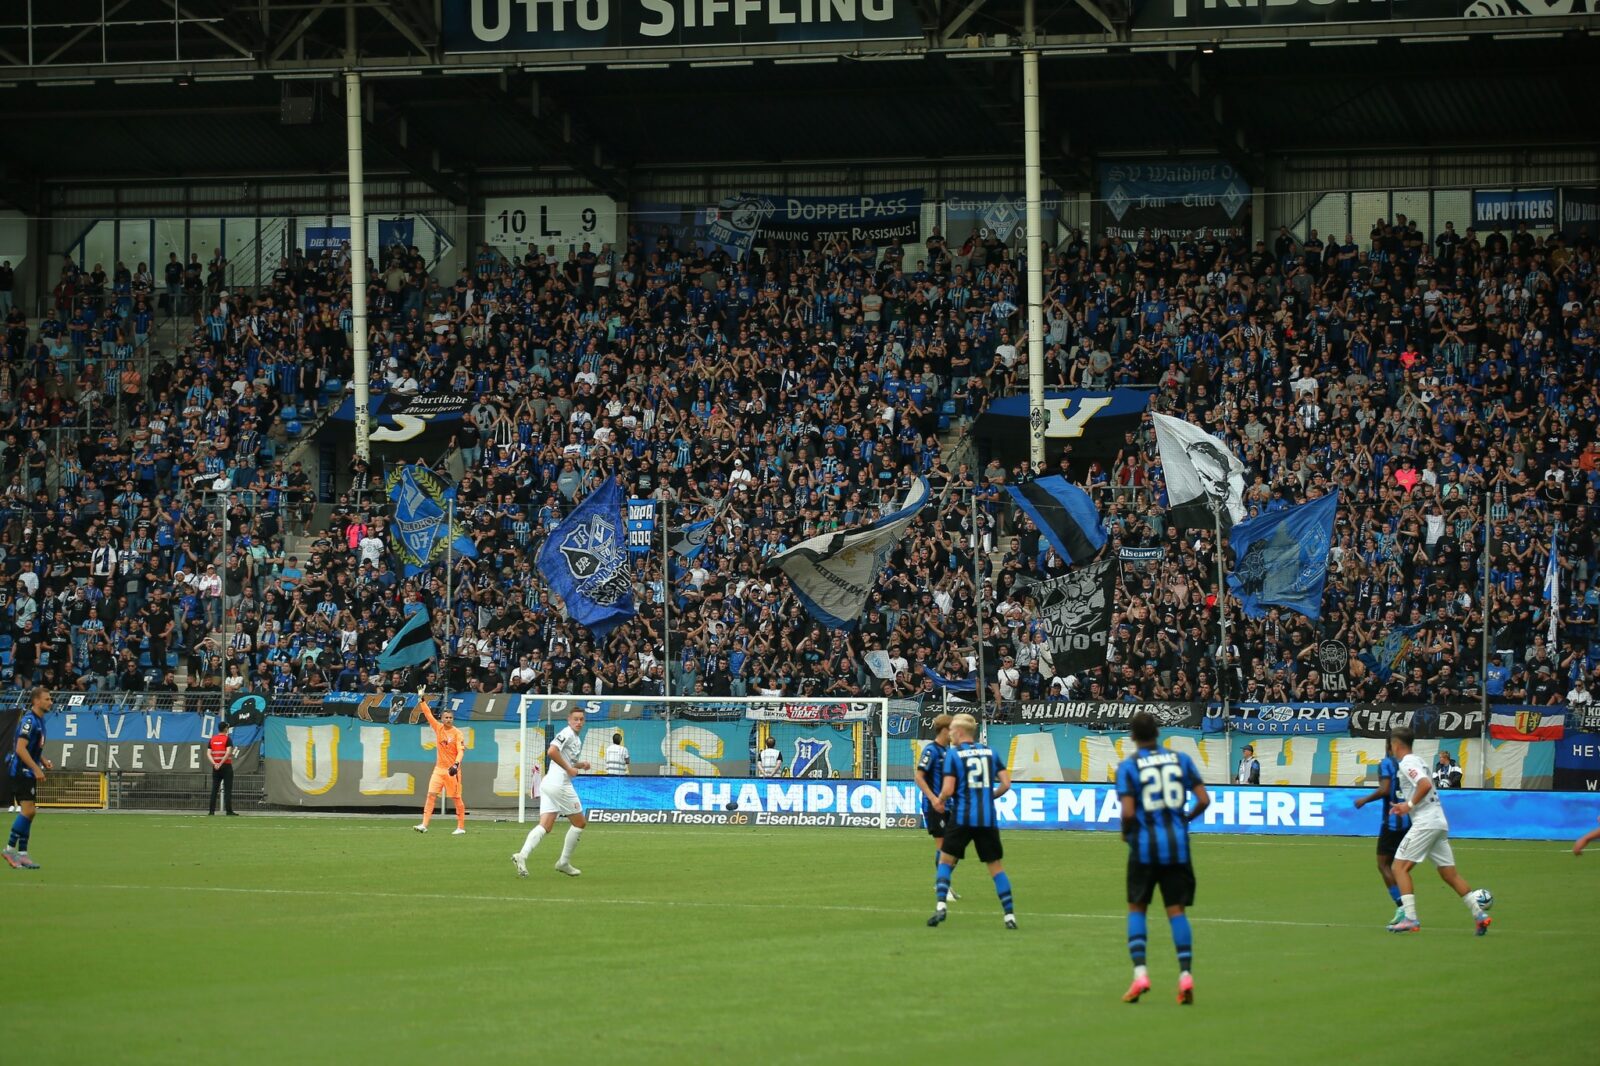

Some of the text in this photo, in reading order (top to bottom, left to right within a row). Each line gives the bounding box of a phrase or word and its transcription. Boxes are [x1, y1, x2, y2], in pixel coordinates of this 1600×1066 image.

[639, 0, 893, 37] SIFFLING
[787, 197, 907, 220] DOPPELPASS
[1477, 200, 1554, 221] KAPUTTICKS
[498, 205, 597, 236] 10 L 9
[756, 229, 809, 241] TIMMUNG
[852, 221, 917, 241] RASSISMUS!
[410, 394, 468, 406] Barrikade
[1229, 721, 1326, 731] MMORTALE
[912, 731, 1530, 790] ANNHEIM
[966, 756, 990, 788] 21
[1140, 764, 1184, 812] 26
[674, 782, 926, 815] CHAMPION
[993, 788, 1045, 822] RE
[1204, 790, 1325, 827] HERE
[588, 809, 748, 826] Eisenbach Tresore.de
[756, 812, 917, 829] Eisenbach Tresoe.de
